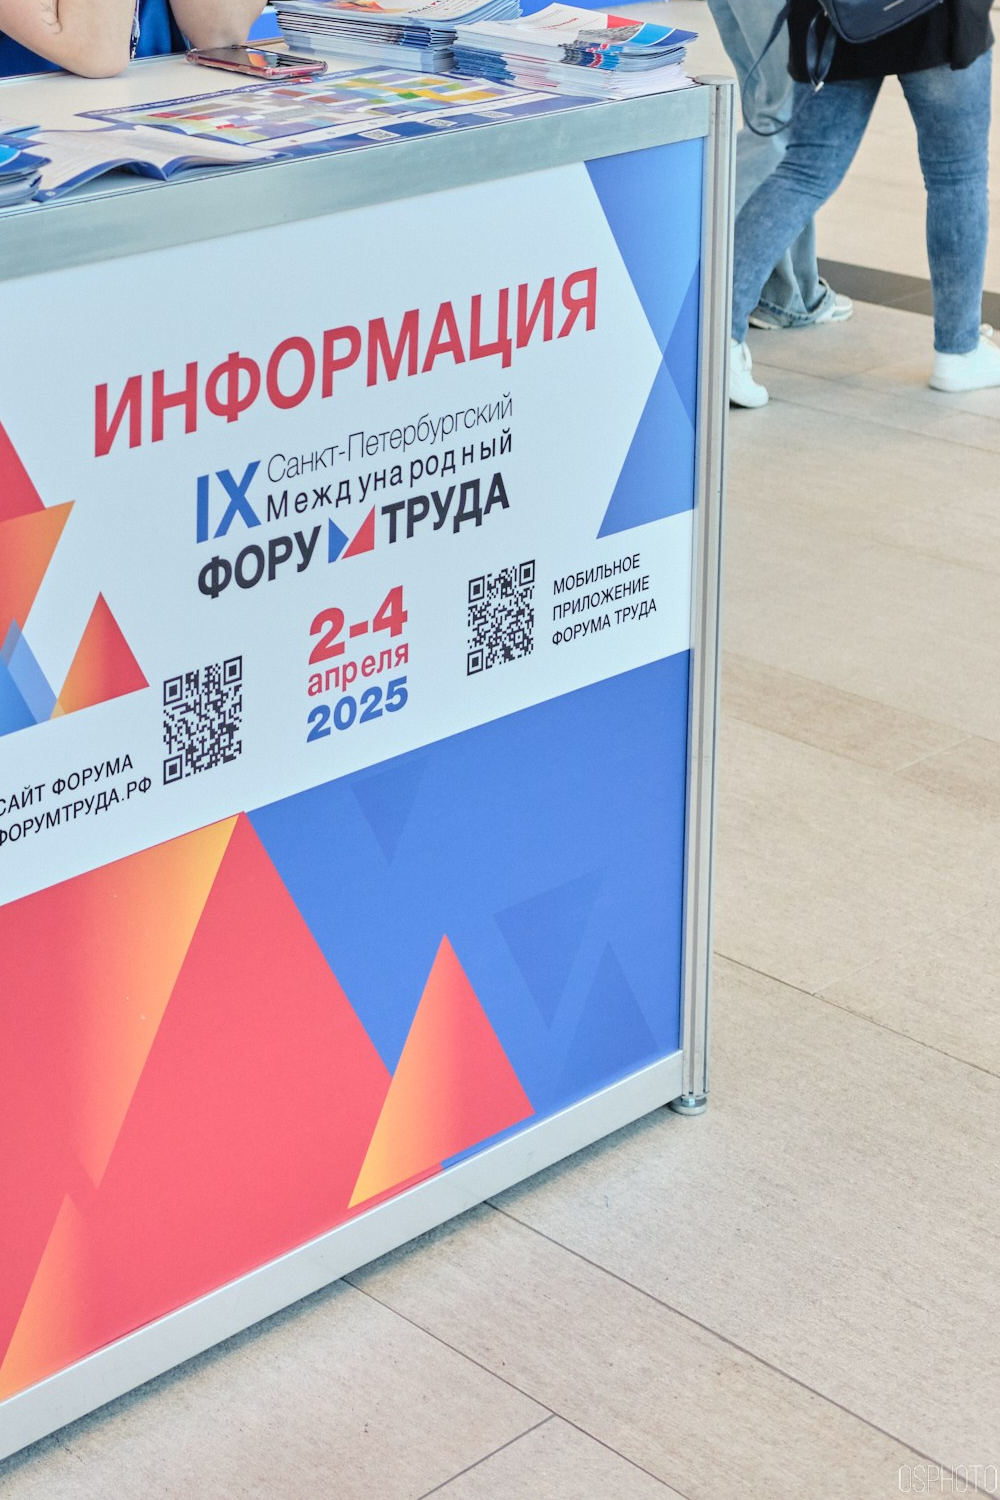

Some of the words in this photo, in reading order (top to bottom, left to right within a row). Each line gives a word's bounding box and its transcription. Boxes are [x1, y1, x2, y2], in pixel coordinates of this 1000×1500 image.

[95, 266, 598, 458] ИНФОРМАЦИЯ
[267, 392, 513, 483] Санкт-Петербургский
[196, 460, 262, 544] IX
[266, 428, 513, 522] Международный
[381, 472, 510, 544] ТРУДА
[552, 575, 650, 621] ПРИЛОЖЕНИЕ
[553, 553, 641, 596] МОБИЛЬНОЕ
[308, 584, 408, 666] 2-4
[552, 614, 611, 646] ФОРУМА
[615, 598, 657, 628] ТРУДА
[308, 643, 409, 697] апреля
[307, 676, 409, 743] 2025
[52, 754, 133, 795] ФОРУМА
